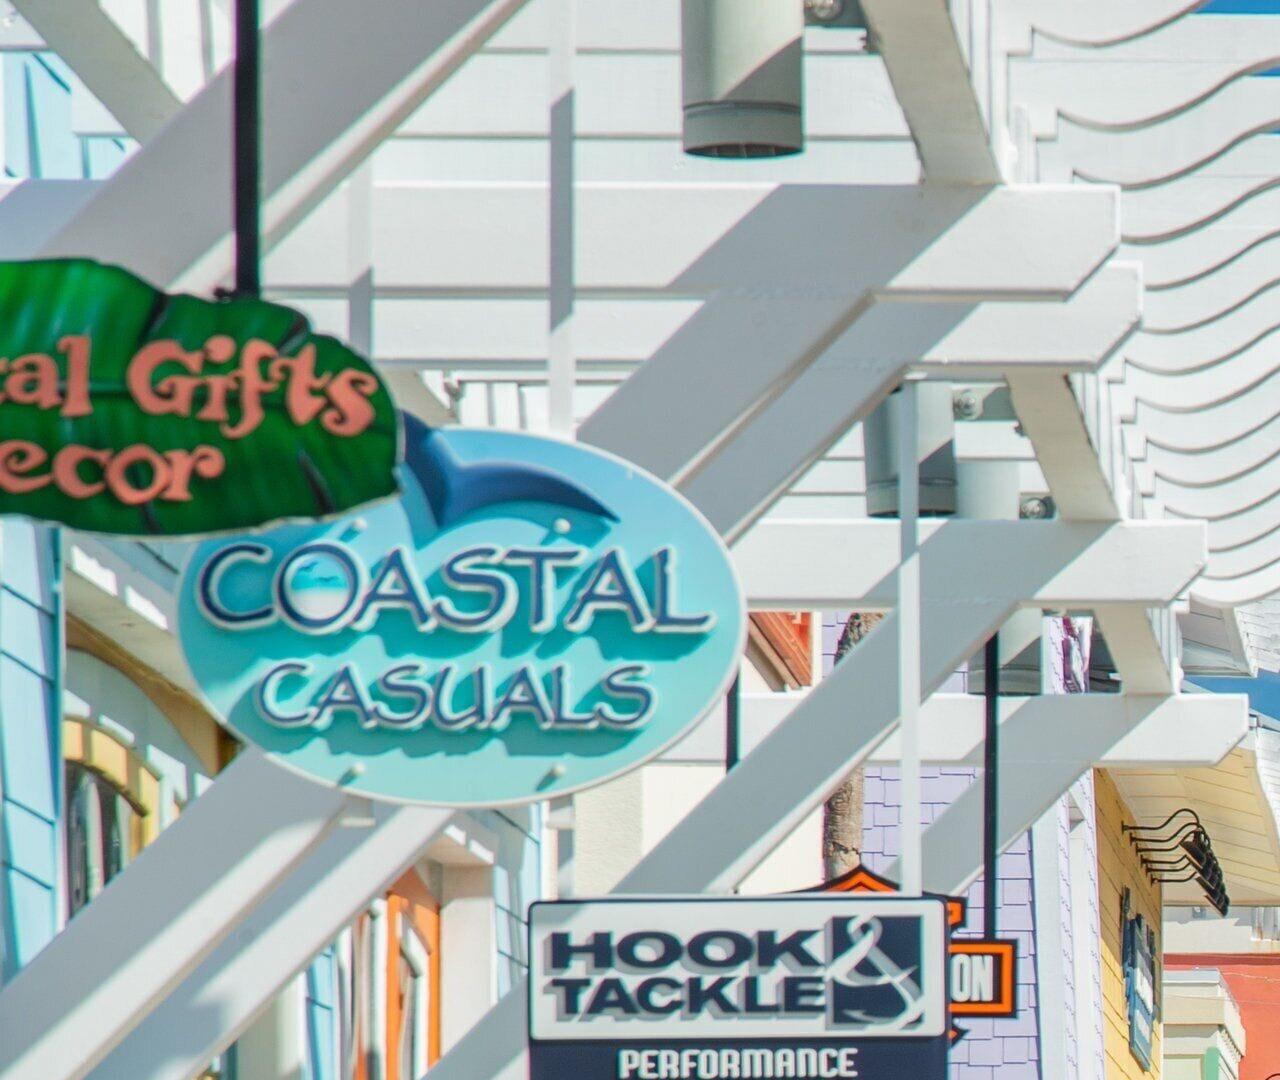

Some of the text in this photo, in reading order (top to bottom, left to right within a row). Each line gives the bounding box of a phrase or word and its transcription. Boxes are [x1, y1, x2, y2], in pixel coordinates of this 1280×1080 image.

[0, 333, 379, 440] al Gifts
[200, 542, 716, 634] COASTAL
[257, 659, 658, 731] CASUALS
[546, 929, 830, 975] HOOK
[544, 976, 829, 1022] TACKLE
